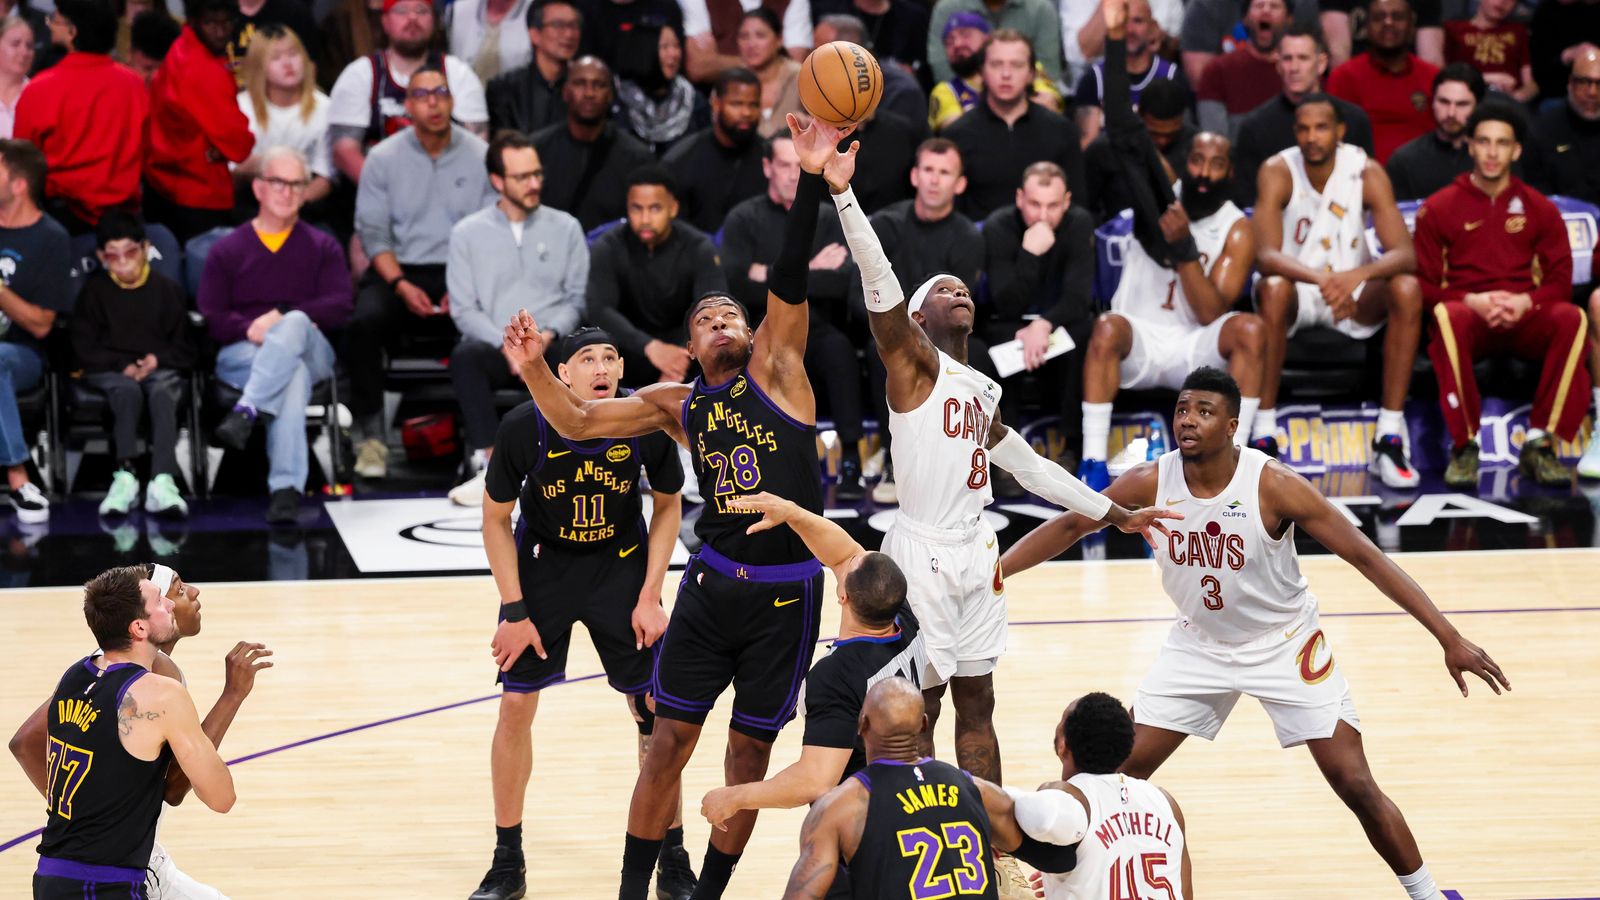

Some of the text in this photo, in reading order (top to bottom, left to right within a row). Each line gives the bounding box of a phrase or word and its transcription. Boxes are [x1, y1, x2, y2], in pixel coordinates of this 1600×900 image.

[849, 44, 870, 94] Wilson
[707, 402, 777, 452] ANGELES
[705, 444, 761, 496] 28
[967, 447, 988, 489] 8
[573, 493, 605, 527] 11
[559, 524, 615, 542] LAKERS
[1169, 530, 1245, 570] CAVS
[1201, 575, 1224, 611] 3
[58, 699, 101, 732] DONČIĆ
[46, 736, 94, 820] 77
[896, 784, 959, 814] JAMES
[1095, 812, 1171, 849] MITCHELL
[897, 821, 989, 900] 23
[1110, 852, 1177, 900] 45
